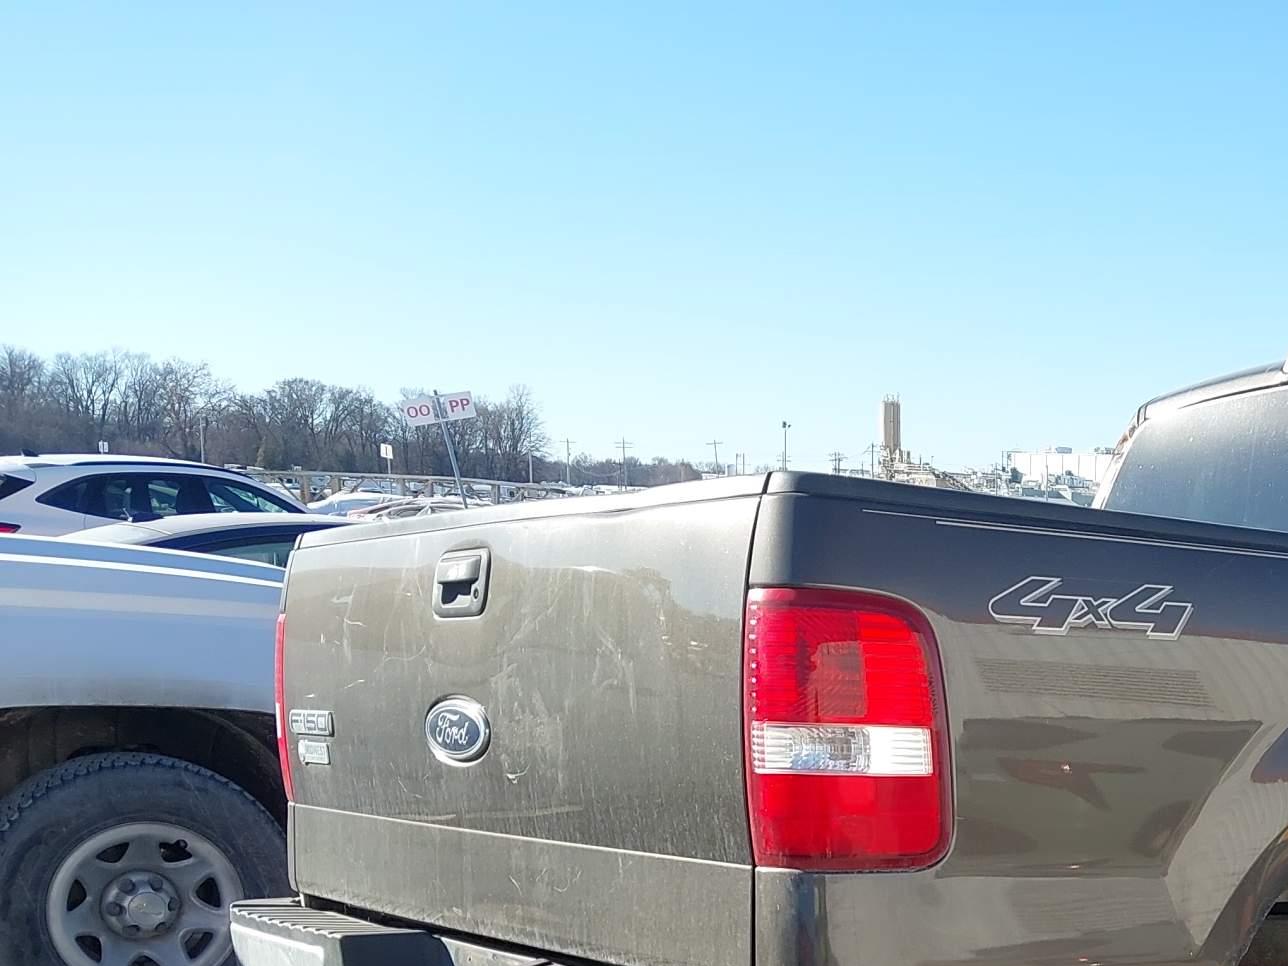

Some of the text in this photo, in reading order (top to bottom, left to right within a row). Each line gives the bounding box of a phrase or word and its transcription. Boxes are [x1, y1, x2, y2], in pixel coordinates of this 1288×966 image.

[407, 404, 430, 418] OO
[448, 398, 470, 413] PP
[988, 576, 1194, 640] 4x4
[435, 711, 470, 746] Ford
